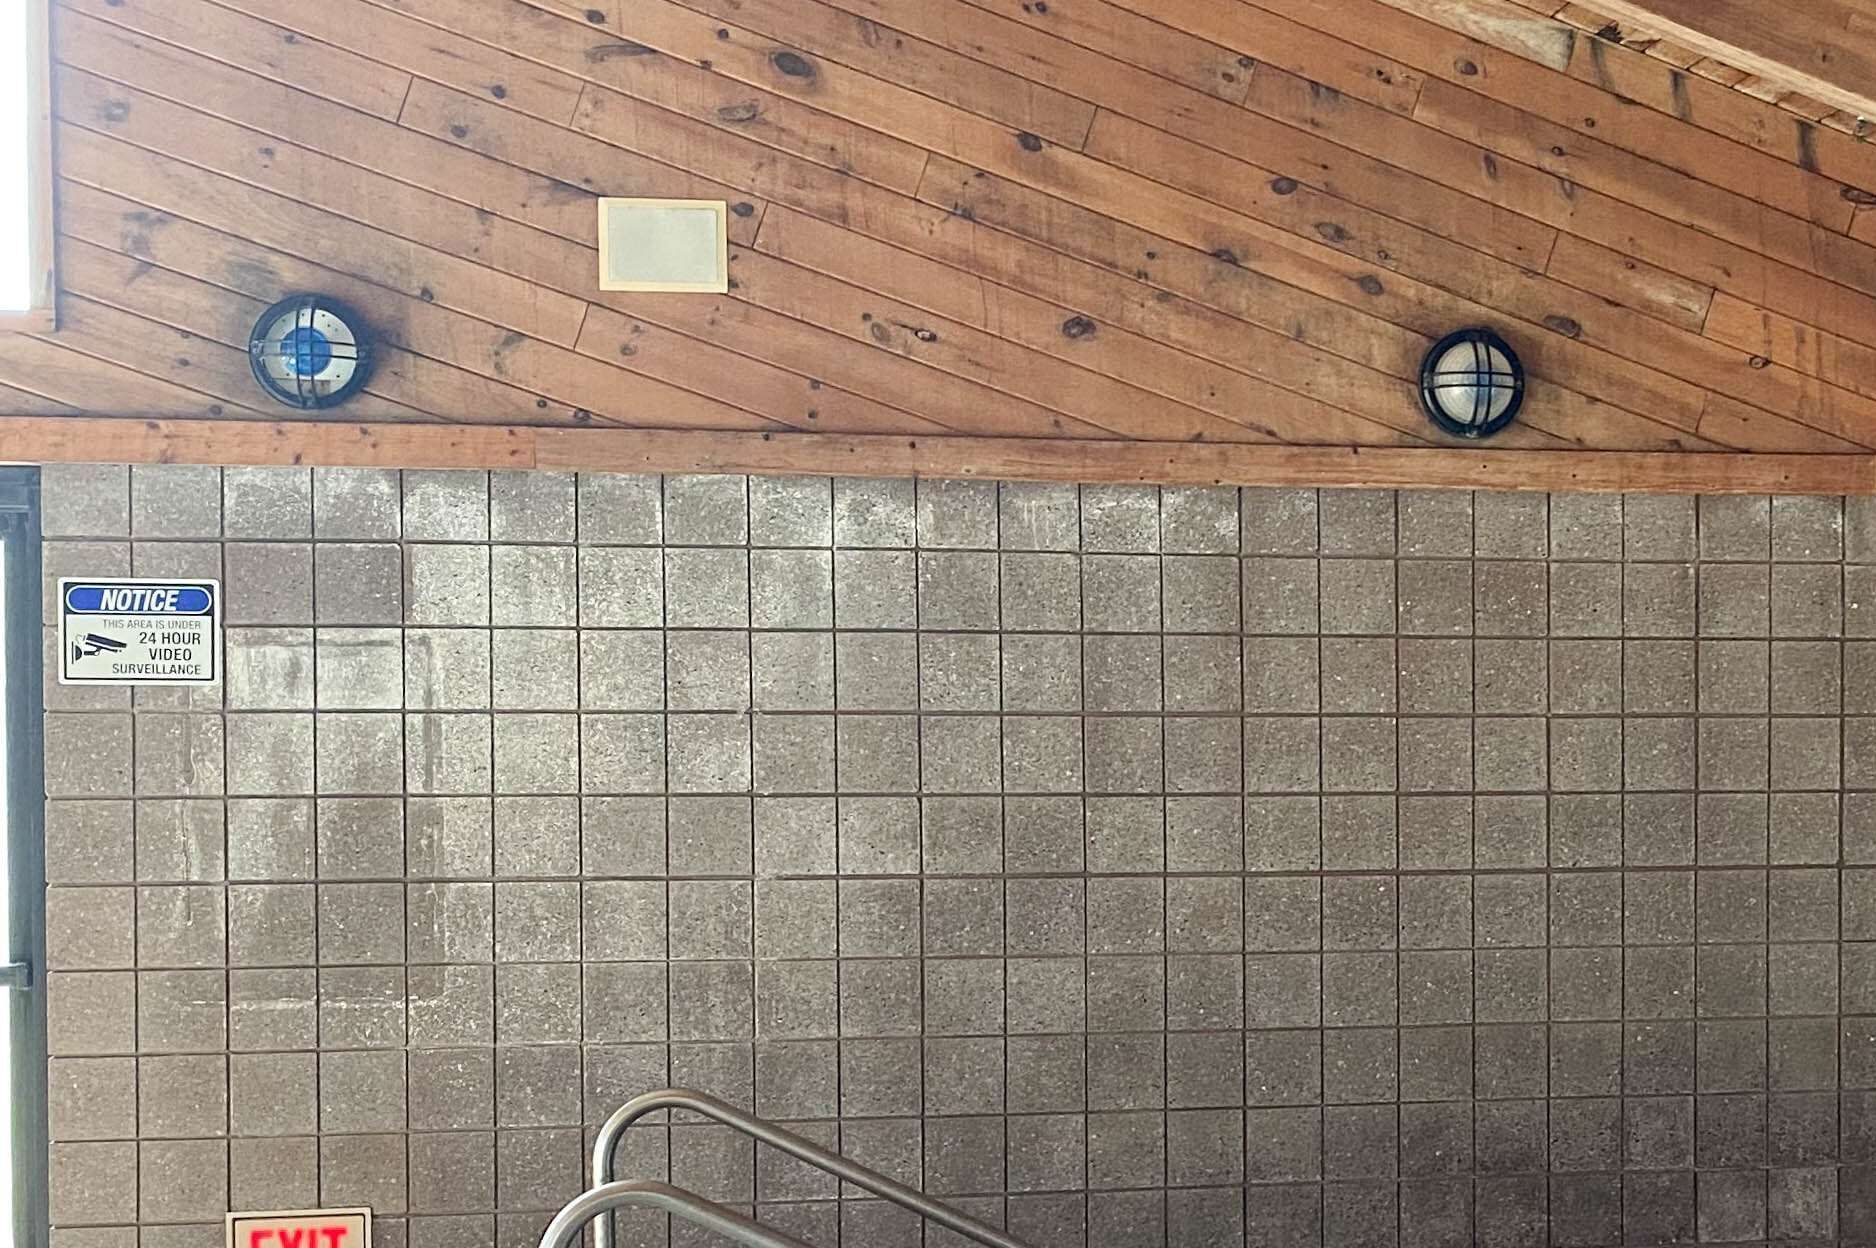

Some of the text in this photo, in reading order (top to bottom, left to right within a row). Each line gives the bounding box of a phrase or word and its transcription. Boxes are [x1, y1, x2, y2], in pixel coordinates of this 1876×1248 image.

[100, 589, 179, 611] NOTICE
[103, 619, 201, 630] THIS AREA IS UNDER
[139, 632, 201, 645] 24 HOUR
[149, 648, 192, 661] VIDEO
[112, 663, 201, 675] SURVEILLANCE
